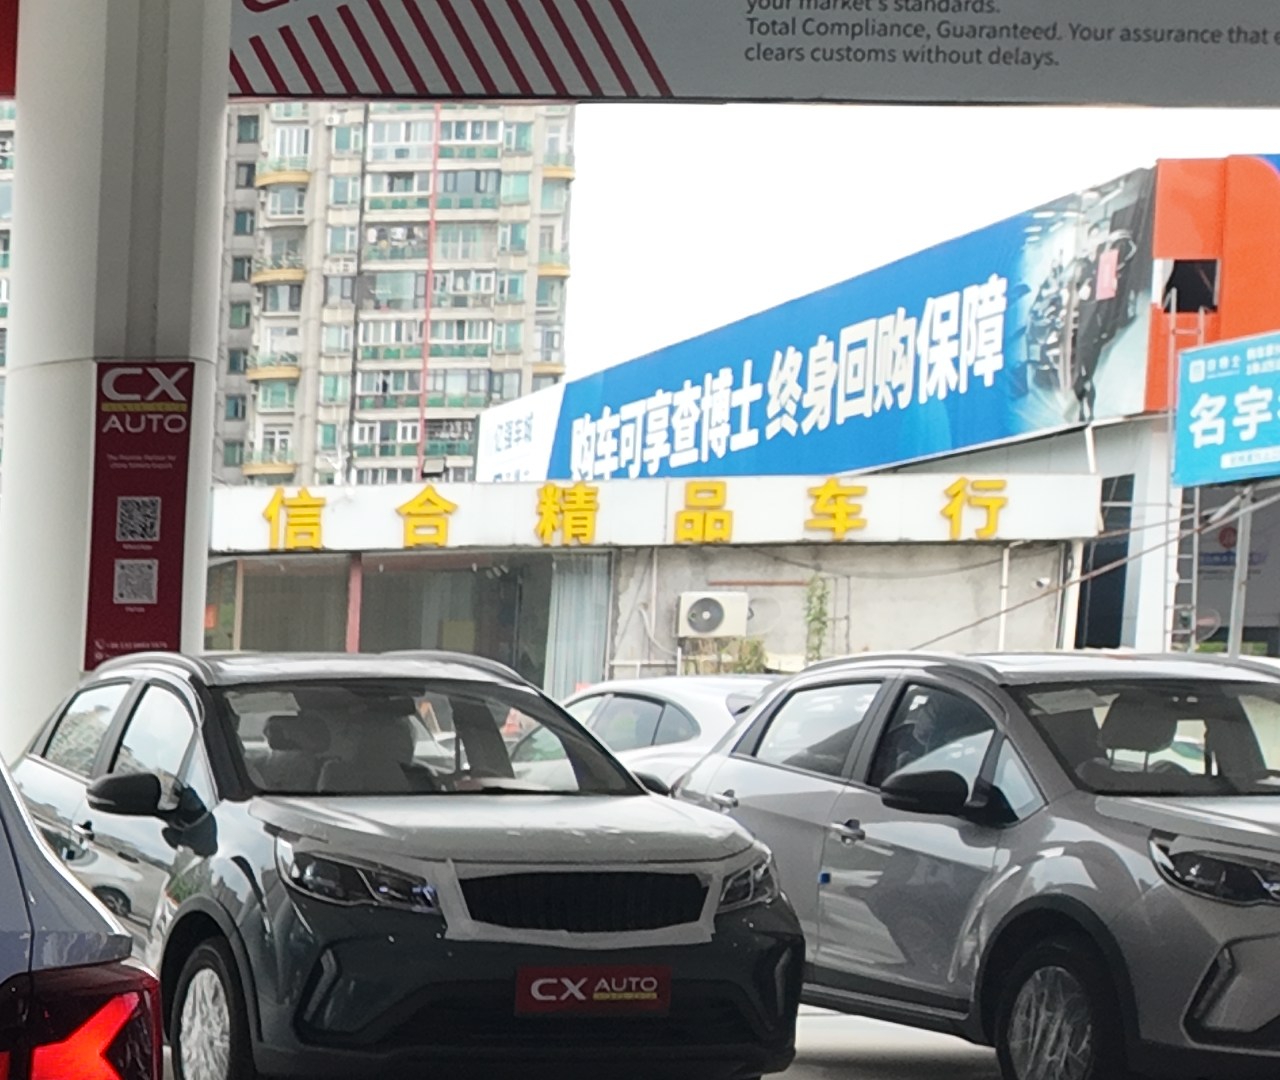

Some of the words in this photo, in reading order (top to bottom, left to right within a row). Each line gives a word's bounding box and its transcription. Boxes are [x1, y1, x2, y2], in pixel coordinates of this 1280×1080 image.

[799, 0, 888, 12] markets
[745, 17, 796, 36] Total
[801, 18, 931, 41] Compliance,
[936, 20, 1062, 41] Guaranteed.
[1067, 23, 1114, 42] Your
[1119, 27, 1223, 44] assurance
[1227, 26, 1269, 45] that
[744, 43, 805, 62] clears
[810, 46, 897, 63] customs
[902, 44, 983, 65] without
[987, 46, 1060, 70] delays.
[101, 367, 189, 401] CX
[569, 358, 763, 481] 购车可享查博士
[765, 272, 1009, 440] 终身回购保障
[102, 413, 187, 434] AUTO
[1188, 385, 1280, 449] 名宇
[263, 476, 1010, 547] 信合精品车行
[531, 977, 588, 1001] CX
[594, 977, 658, 992] AUTO
